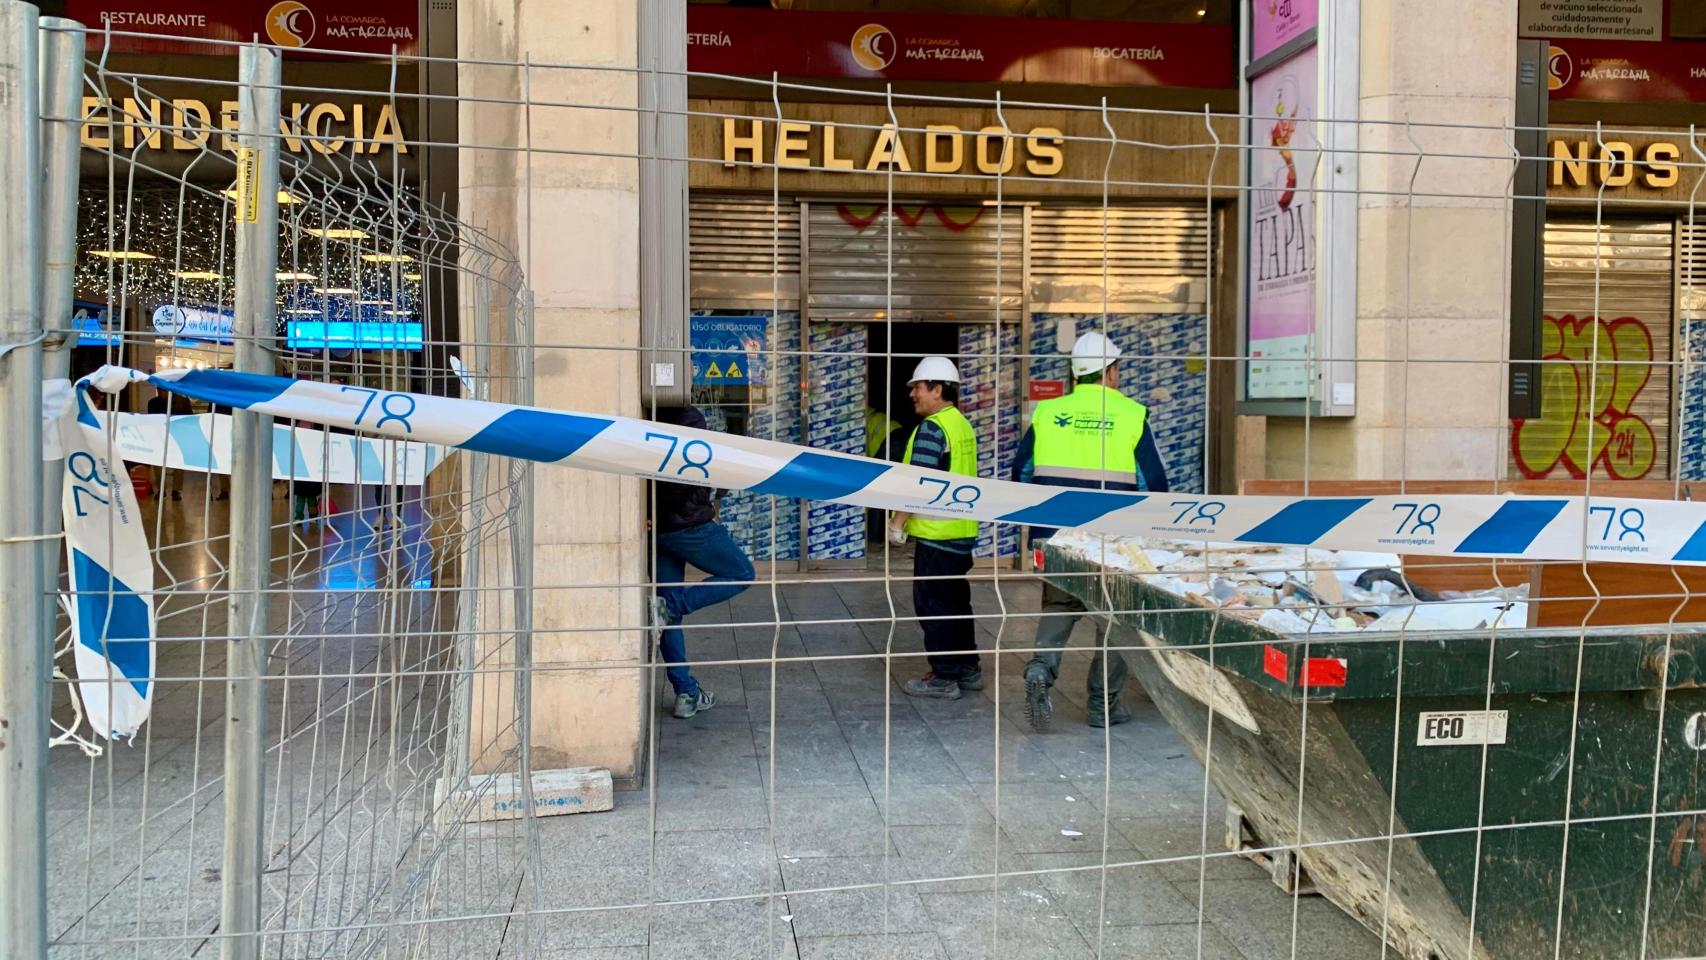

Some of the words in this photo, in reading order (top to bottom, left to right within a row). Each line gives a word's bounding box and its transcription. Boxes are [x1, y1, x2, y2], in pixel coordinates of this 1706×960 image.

[1540, 2, 1551, 11] de
[1553, 4, 1585, 12] vacuno
[1586, 4, 1643, 14] seleccionada
[100, 11, 206, 27] RESTAURANTE
[326, 15, 339, 23] LA
[340, 16, 386, 25] COMARCA
[1551, 14, 1624, 24] cuidadosamente
[1625, 17, 1631, 26] y
[326, 25, 414, 40] MATARRAÑA
[687, 30, 732, 47] ETERÍA
[1528, 23, 1572, 33] elaborada
[1586, 24, 1613, 34] forma
[1614, 26, 1655, 36] artesanal
[905, 47, 985, 62] MATARRAÑA
[1093, 45, 1165, 61] BOCATERÍA
[1580, 67, 1651, 82] MATARRAÑA
[724, 118, 1065, 175] HELADOS
[1553, 140, 1681, 188] NOS
[710, 322, 763, 333] OBLIGATORIO
[341, 386, 416, 433] 78
[645, 432, 713, 479] 78
[1616, 428, 1636, 466] 24
[68, 451, 109, 517] 78
[919, 476, 981, 508] 78
[1170, 501, 1226, 526] 78
[1392, 503, 1441, 535] 78
[1590, 506, 1646, 542] 78
[1425, 717, 1465, 740] ECO
